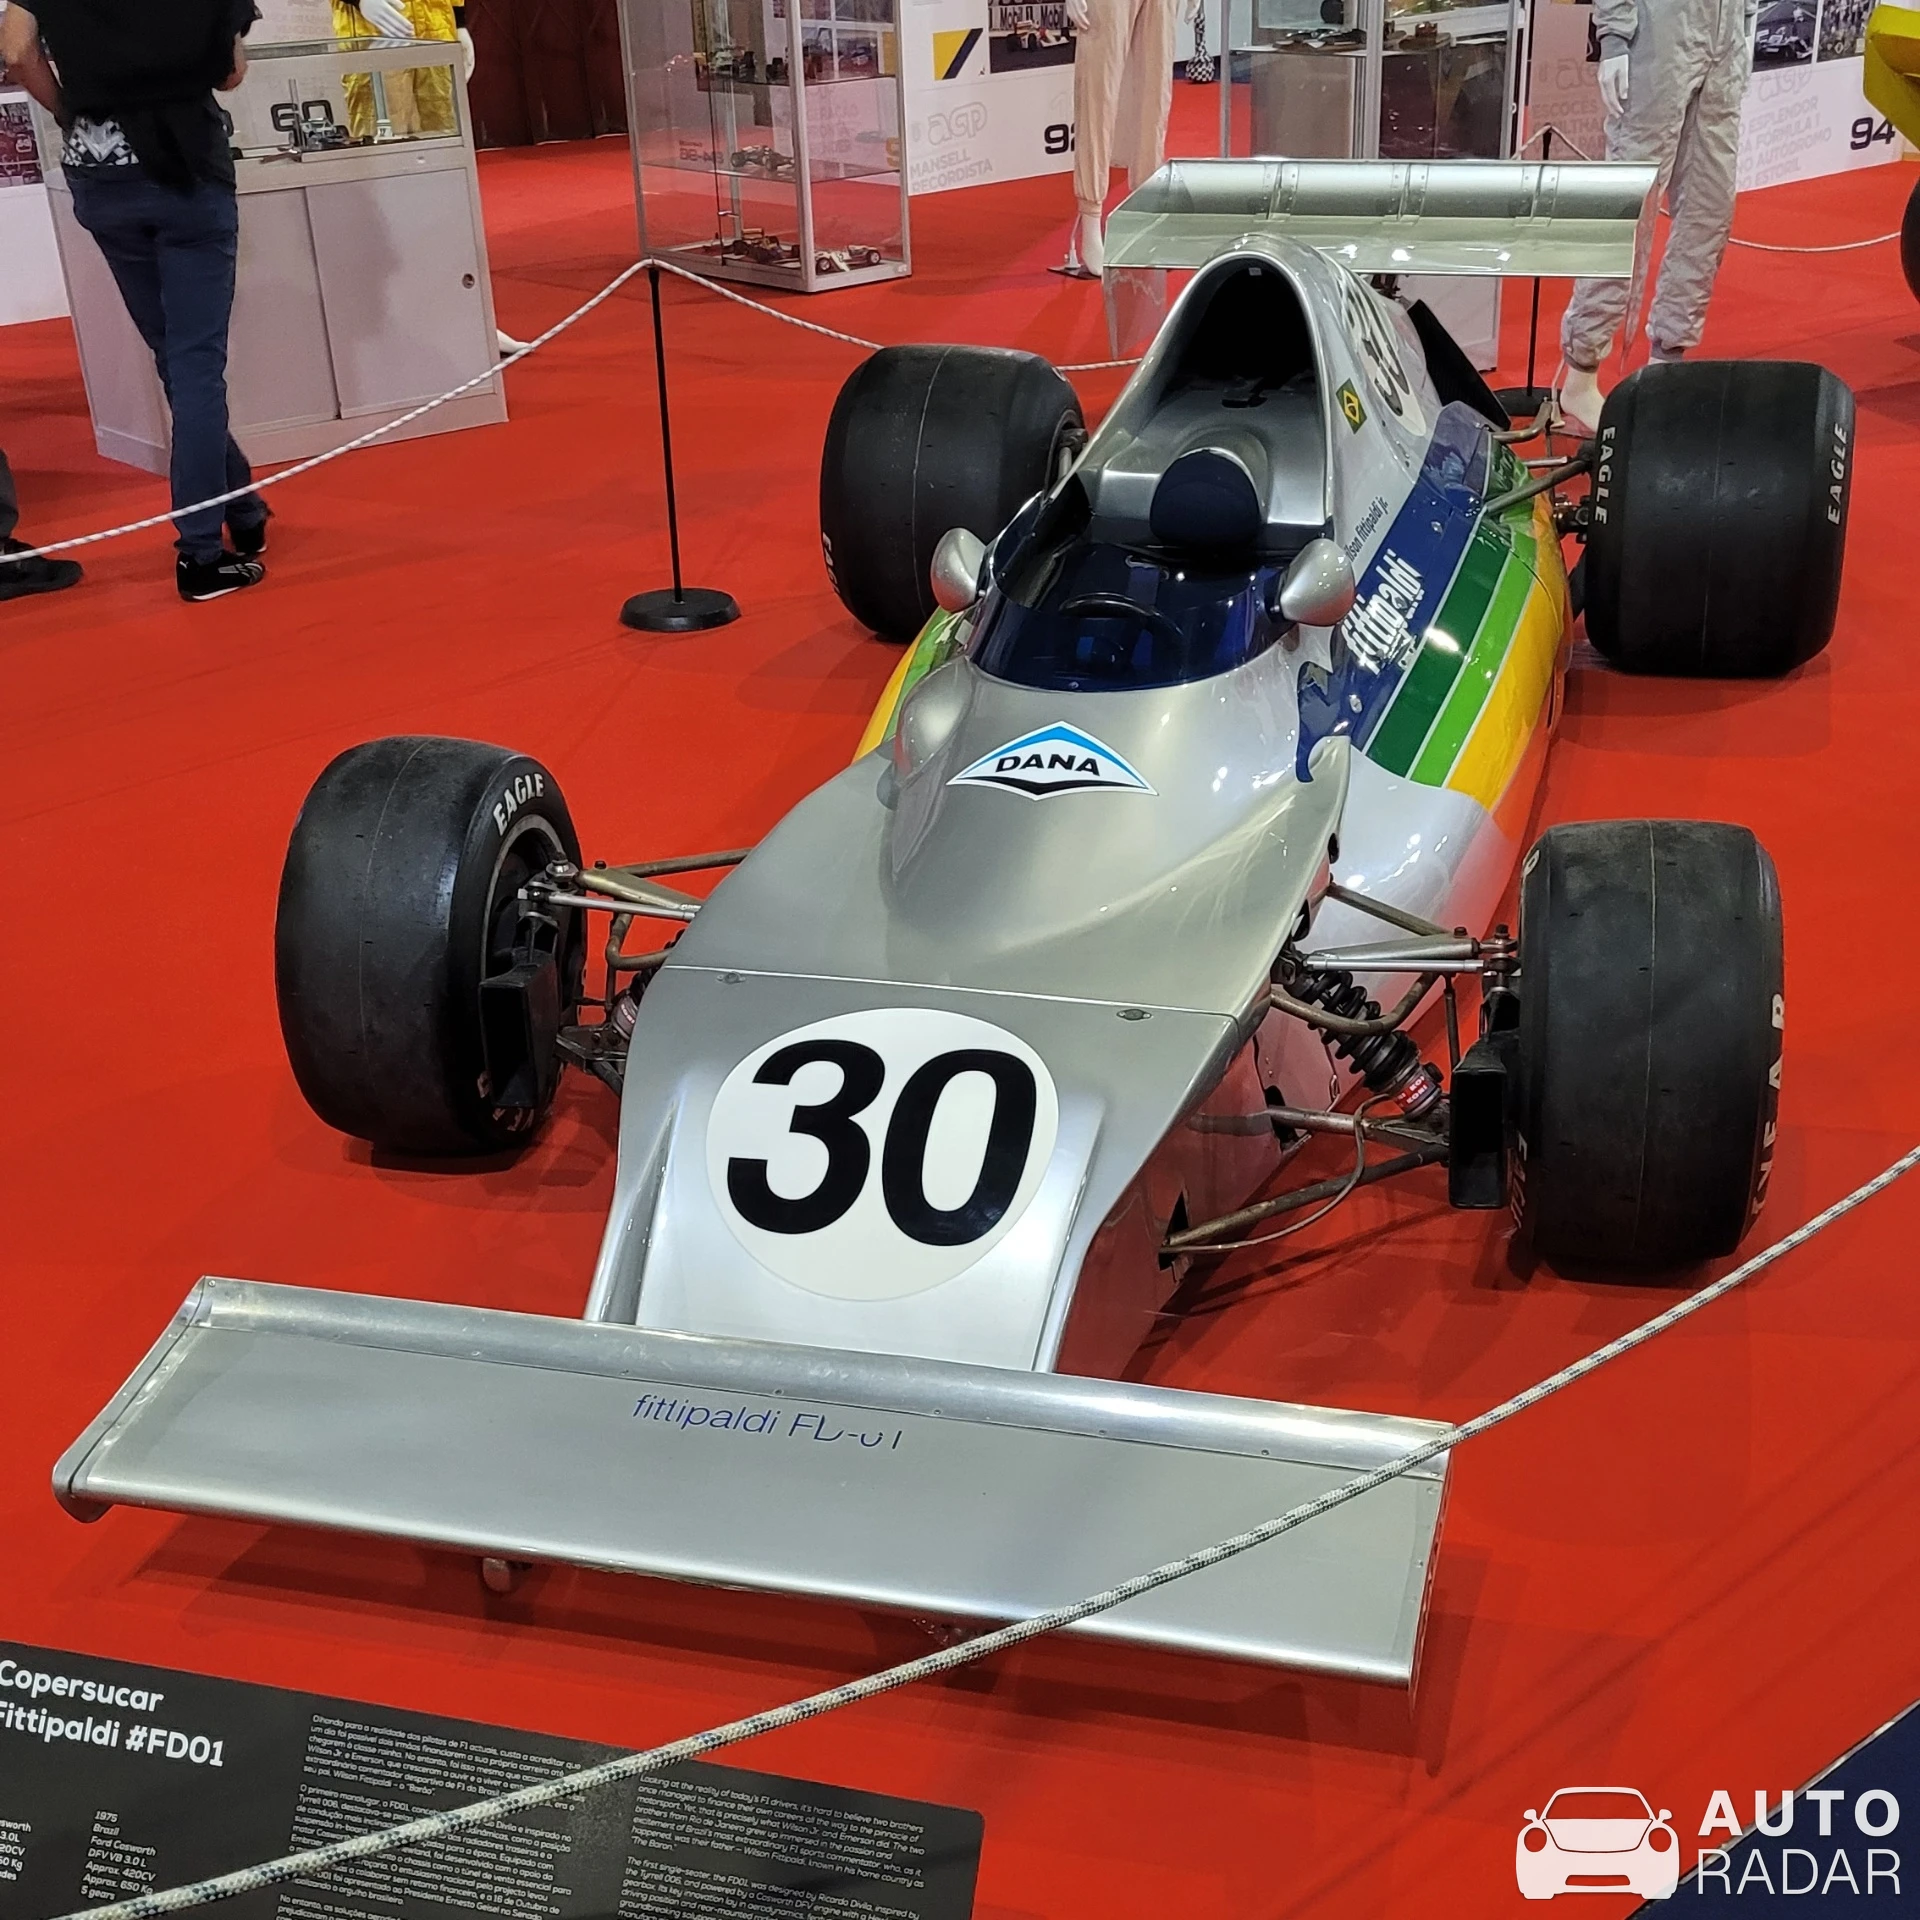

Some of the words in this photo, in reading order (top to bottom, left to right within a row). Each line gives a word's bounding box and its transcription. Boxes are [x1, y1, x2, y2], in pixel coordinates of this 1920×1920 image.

[1044, 124, 1076, 154] 9
[1850, 117, 1895, 150] 94
[910, 148, 972, 179] MANSELL
[1595, 426, 1616, 525] EAGLE
[1827, 422, 1848, 525] EAGLE
[995, 753, 1101, 777] DANA
[493, 772, 545, 836] EAGLE
[727, 1039, 1037, 1246] 30
[632, 1394, 781, 1436] fittipaldi
[0, 1659, 164, 1712] Copersucar
[126, 1724, 224, 1767] #FD01
[93, 1823, 120, 1836] Brazil
[94, 1811, 118, 1822] 1975
[88, 1848, 110, 1860] DFV
[109, 1852, 123, 1862] V8
[124, 1855, 140, 1866] 3.0
[140, 1858, 147, 1868] L
[90, 1836, 112, 1848] Ford
[113, 1840, 156, 1856] Cosworth
[11, 1858, 23, 1872] Kg
[122, 1868, 156, 1882] 420CV
[80, 1885, 88, 1894] 5
[88, 1889, 116, 1900] gears
[120, 1880, 140, 1892] 650
